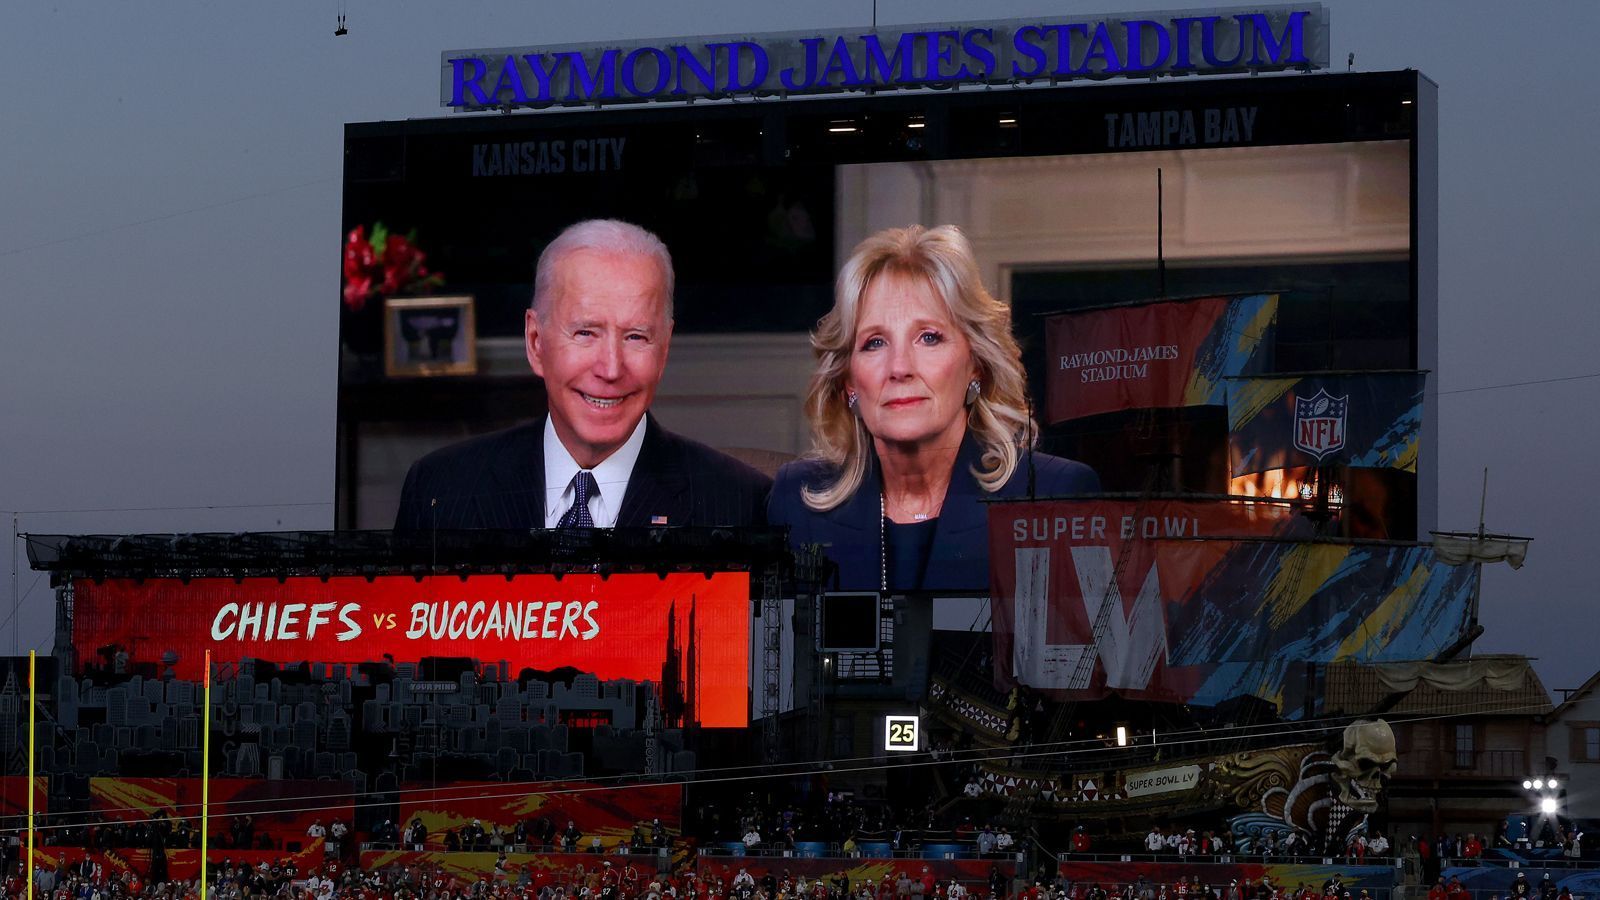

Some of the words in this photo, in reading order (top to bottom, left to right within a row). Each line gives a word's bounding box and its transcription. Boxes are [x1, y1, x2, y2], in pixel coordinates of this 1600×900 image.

[448, 42, 769, 107] RAYMOND
[780, 27, 997, 91] JAMES
[1012, 11, 1310, 77] STADIUM
[1106, 110, 1196, 148] TAMPA
[1204, 107, 1257, 144] BAY
[472, 140, 566, 176] KANSAS
[571, 136, 626, 173] CITY
[1059, 349, 1129, 370] RAYMOND
[1131, 345, 1179, 363] JAMES
[1080, 363, 1148, 384] STADIUM
[1300, 419, 1340, 449] NFL
[1013, 517, 1106, 541] SUPER
[211, 602, 362, 642] CHIEFS
[373, 614, 397, 630] VS
[406, 600, 600, 640] BUCCANEERS
[1013, 545, 1169, 690] LV
[433, 682, 457, 691] MIND
[890, 724, 914, 743] 25
[1129, 778, 1154, 791] SUPER
[1155, 775, 1180, 787] BOWL
[1182, 773, 1194, 783] LV
